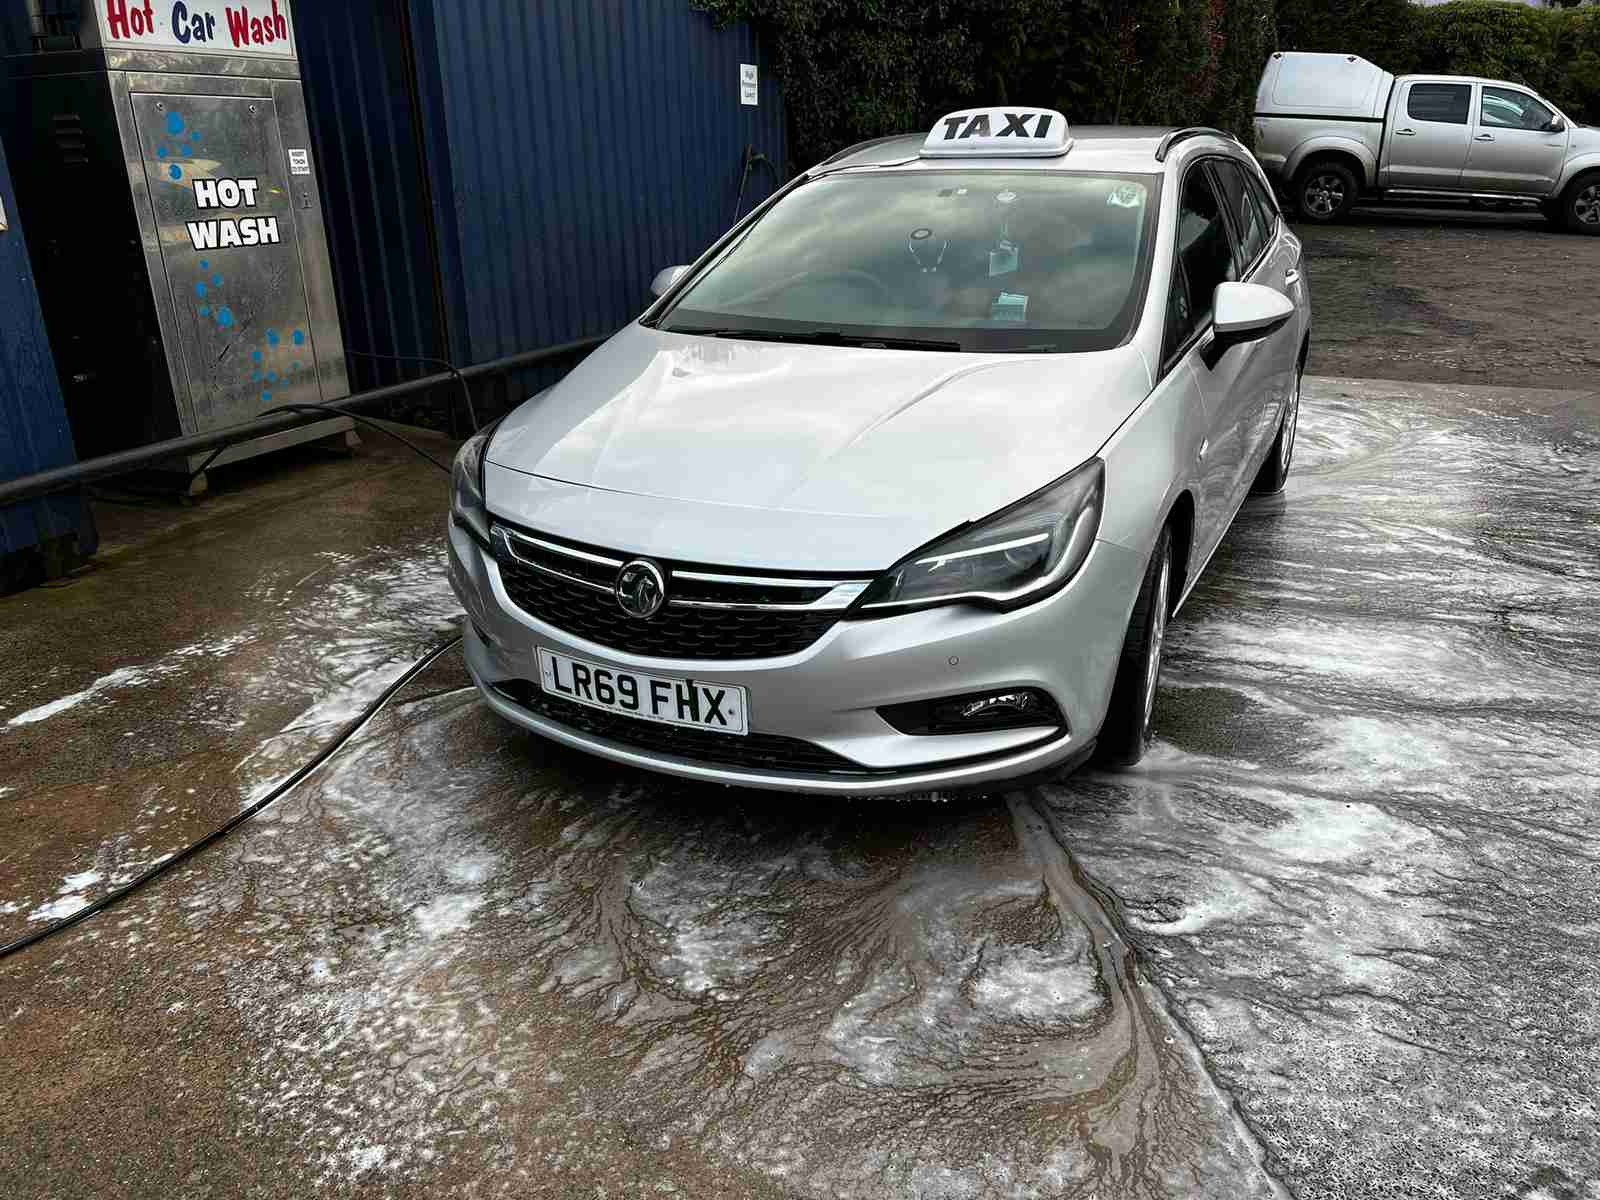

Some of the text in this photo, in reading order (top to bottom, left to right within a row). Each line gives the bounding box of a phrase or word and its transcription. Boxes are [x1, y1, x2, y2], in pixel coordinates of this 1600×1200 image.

[107, 0, 287, 48] Hot Car Wash
[943, 113, 1053, 140] TAXI
[192, 178, 259, 209] HOT
[185, 216, 281, 251] WASH
[551, 656, 727, 726] LR69 FHX
